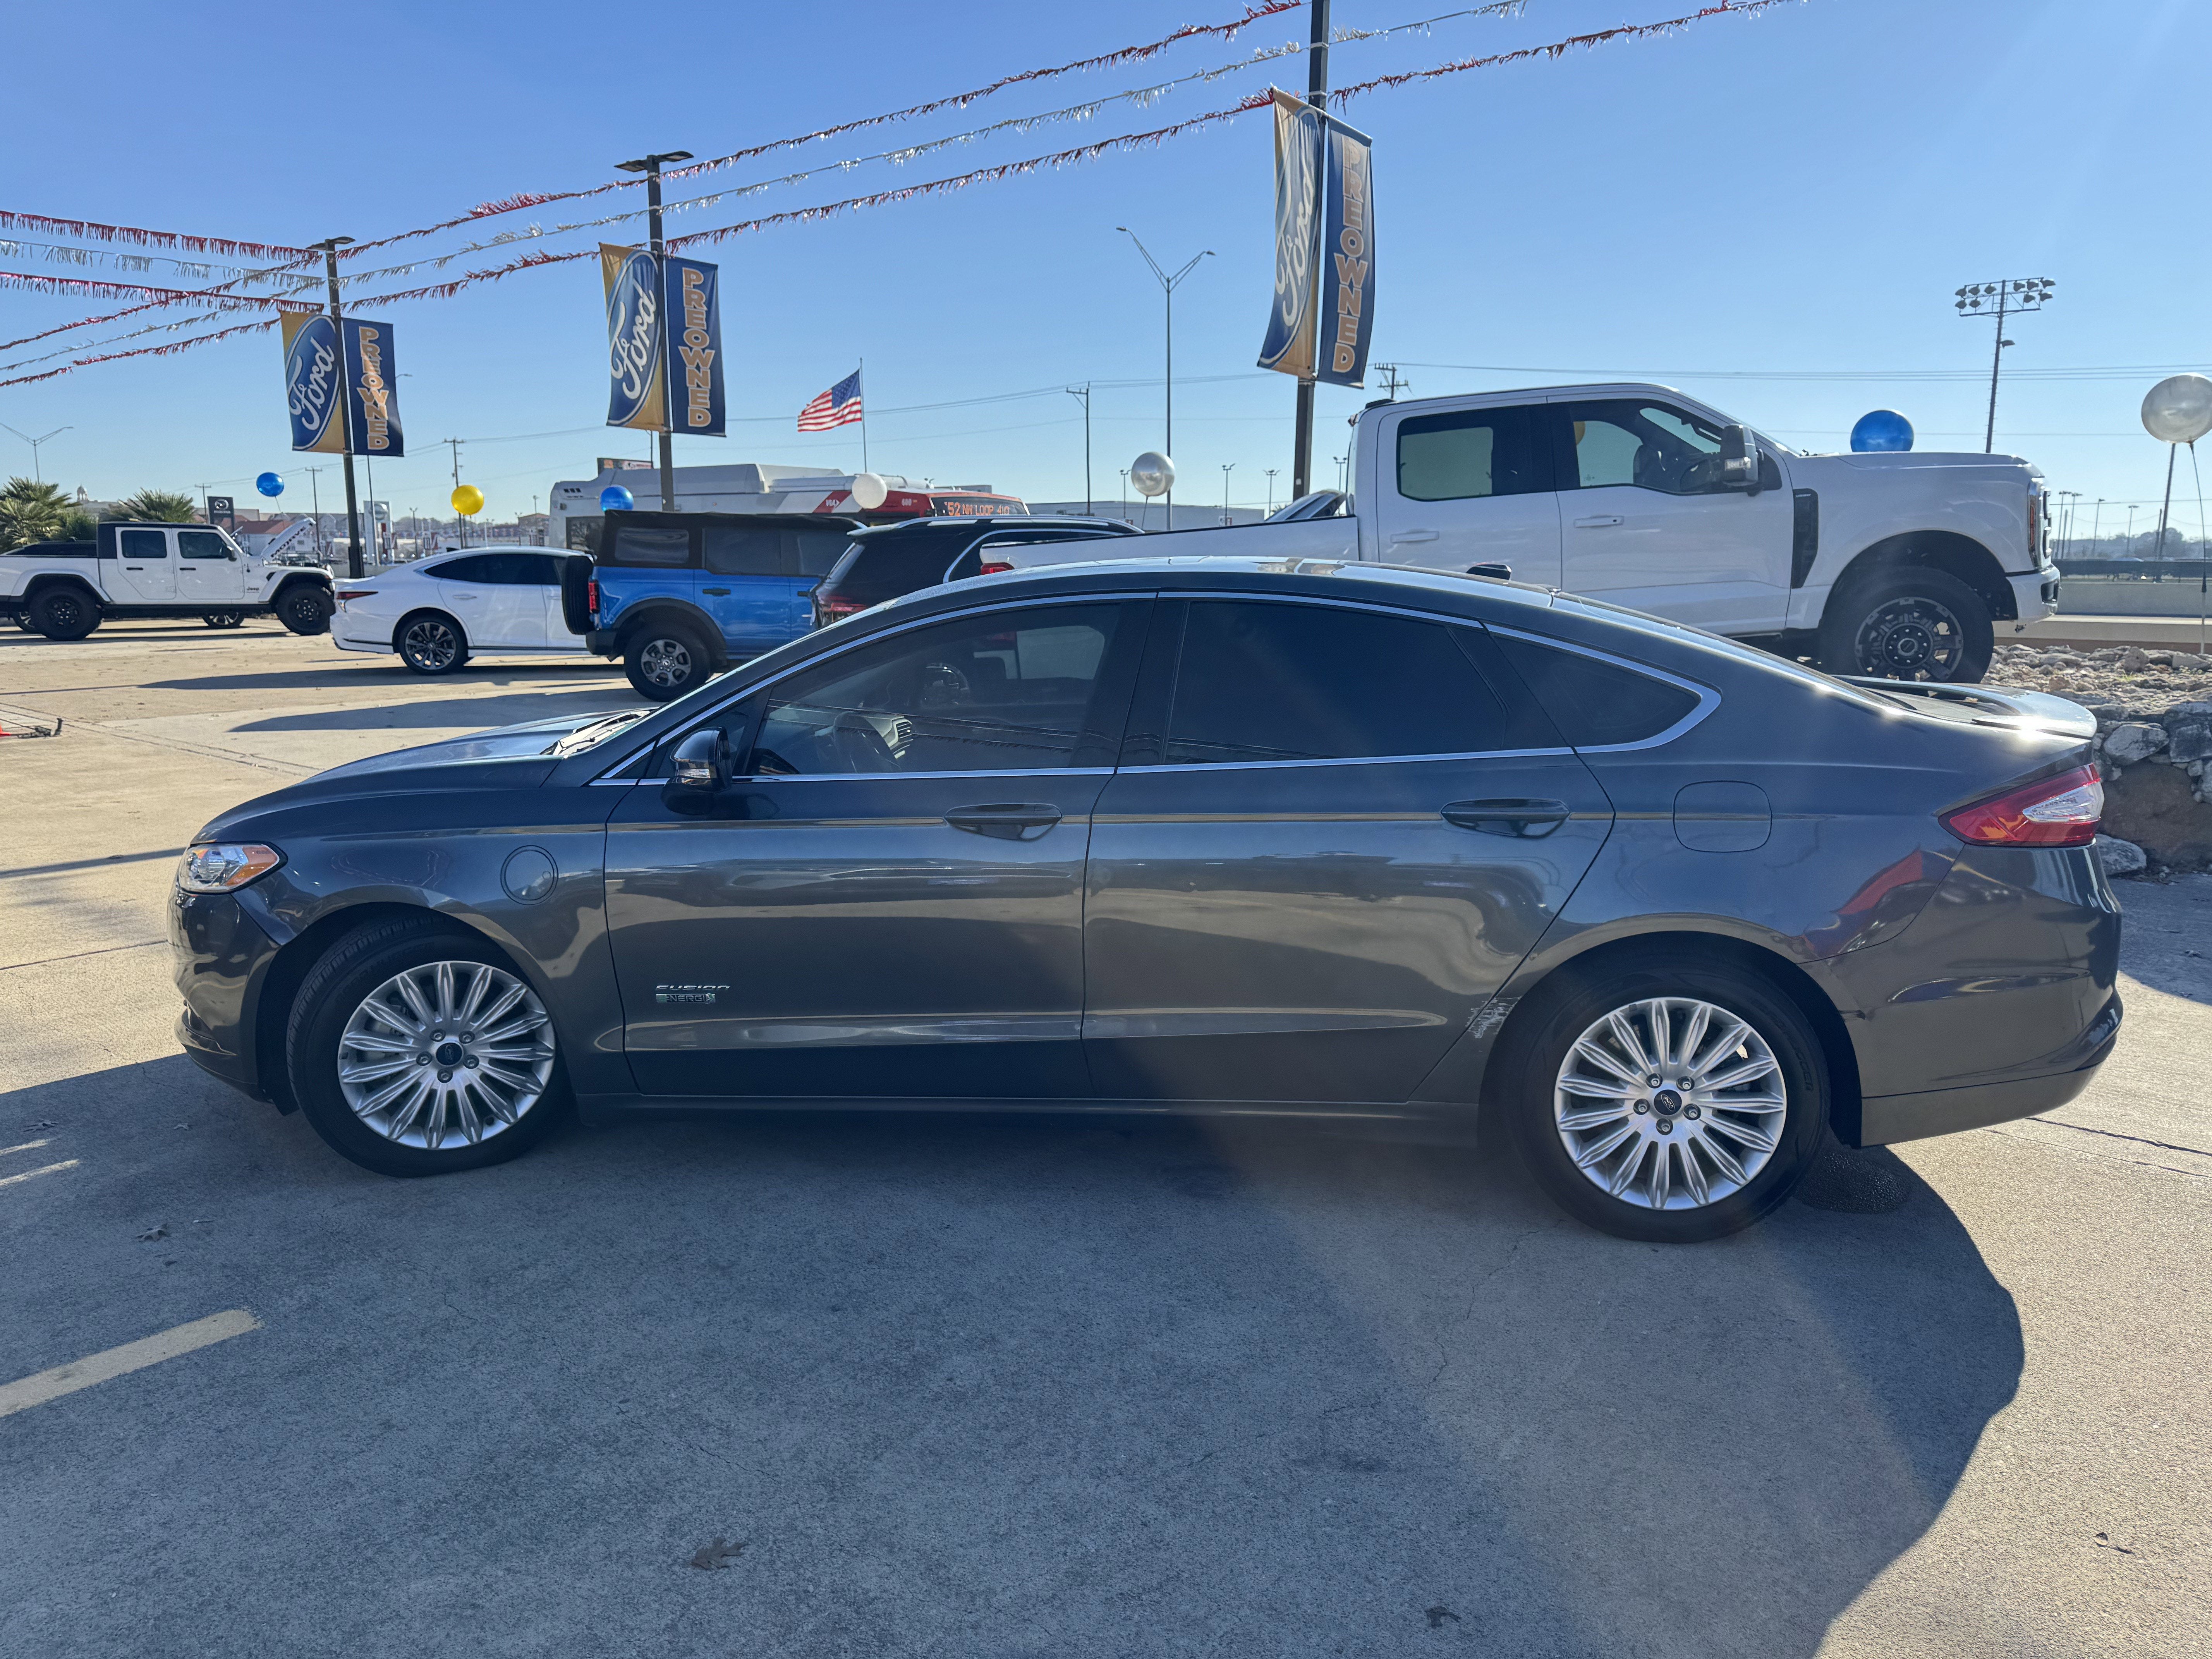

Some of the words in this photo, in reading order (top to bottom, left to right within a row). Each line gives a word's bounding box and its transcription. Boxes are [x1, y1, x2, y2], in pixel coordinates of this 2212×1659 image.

[1276, 121, 1315, 327] Ford
[1332, 135, 1368, 373] PREOWNED
[288, 336, 335, 431] Ford
[356, 326, 390, 450] PREOWNED
[610, 277, 656, 400] Ford
[678, 266, 716, 427] PREOWNED
[975, 505, 994, 516] LOOP
